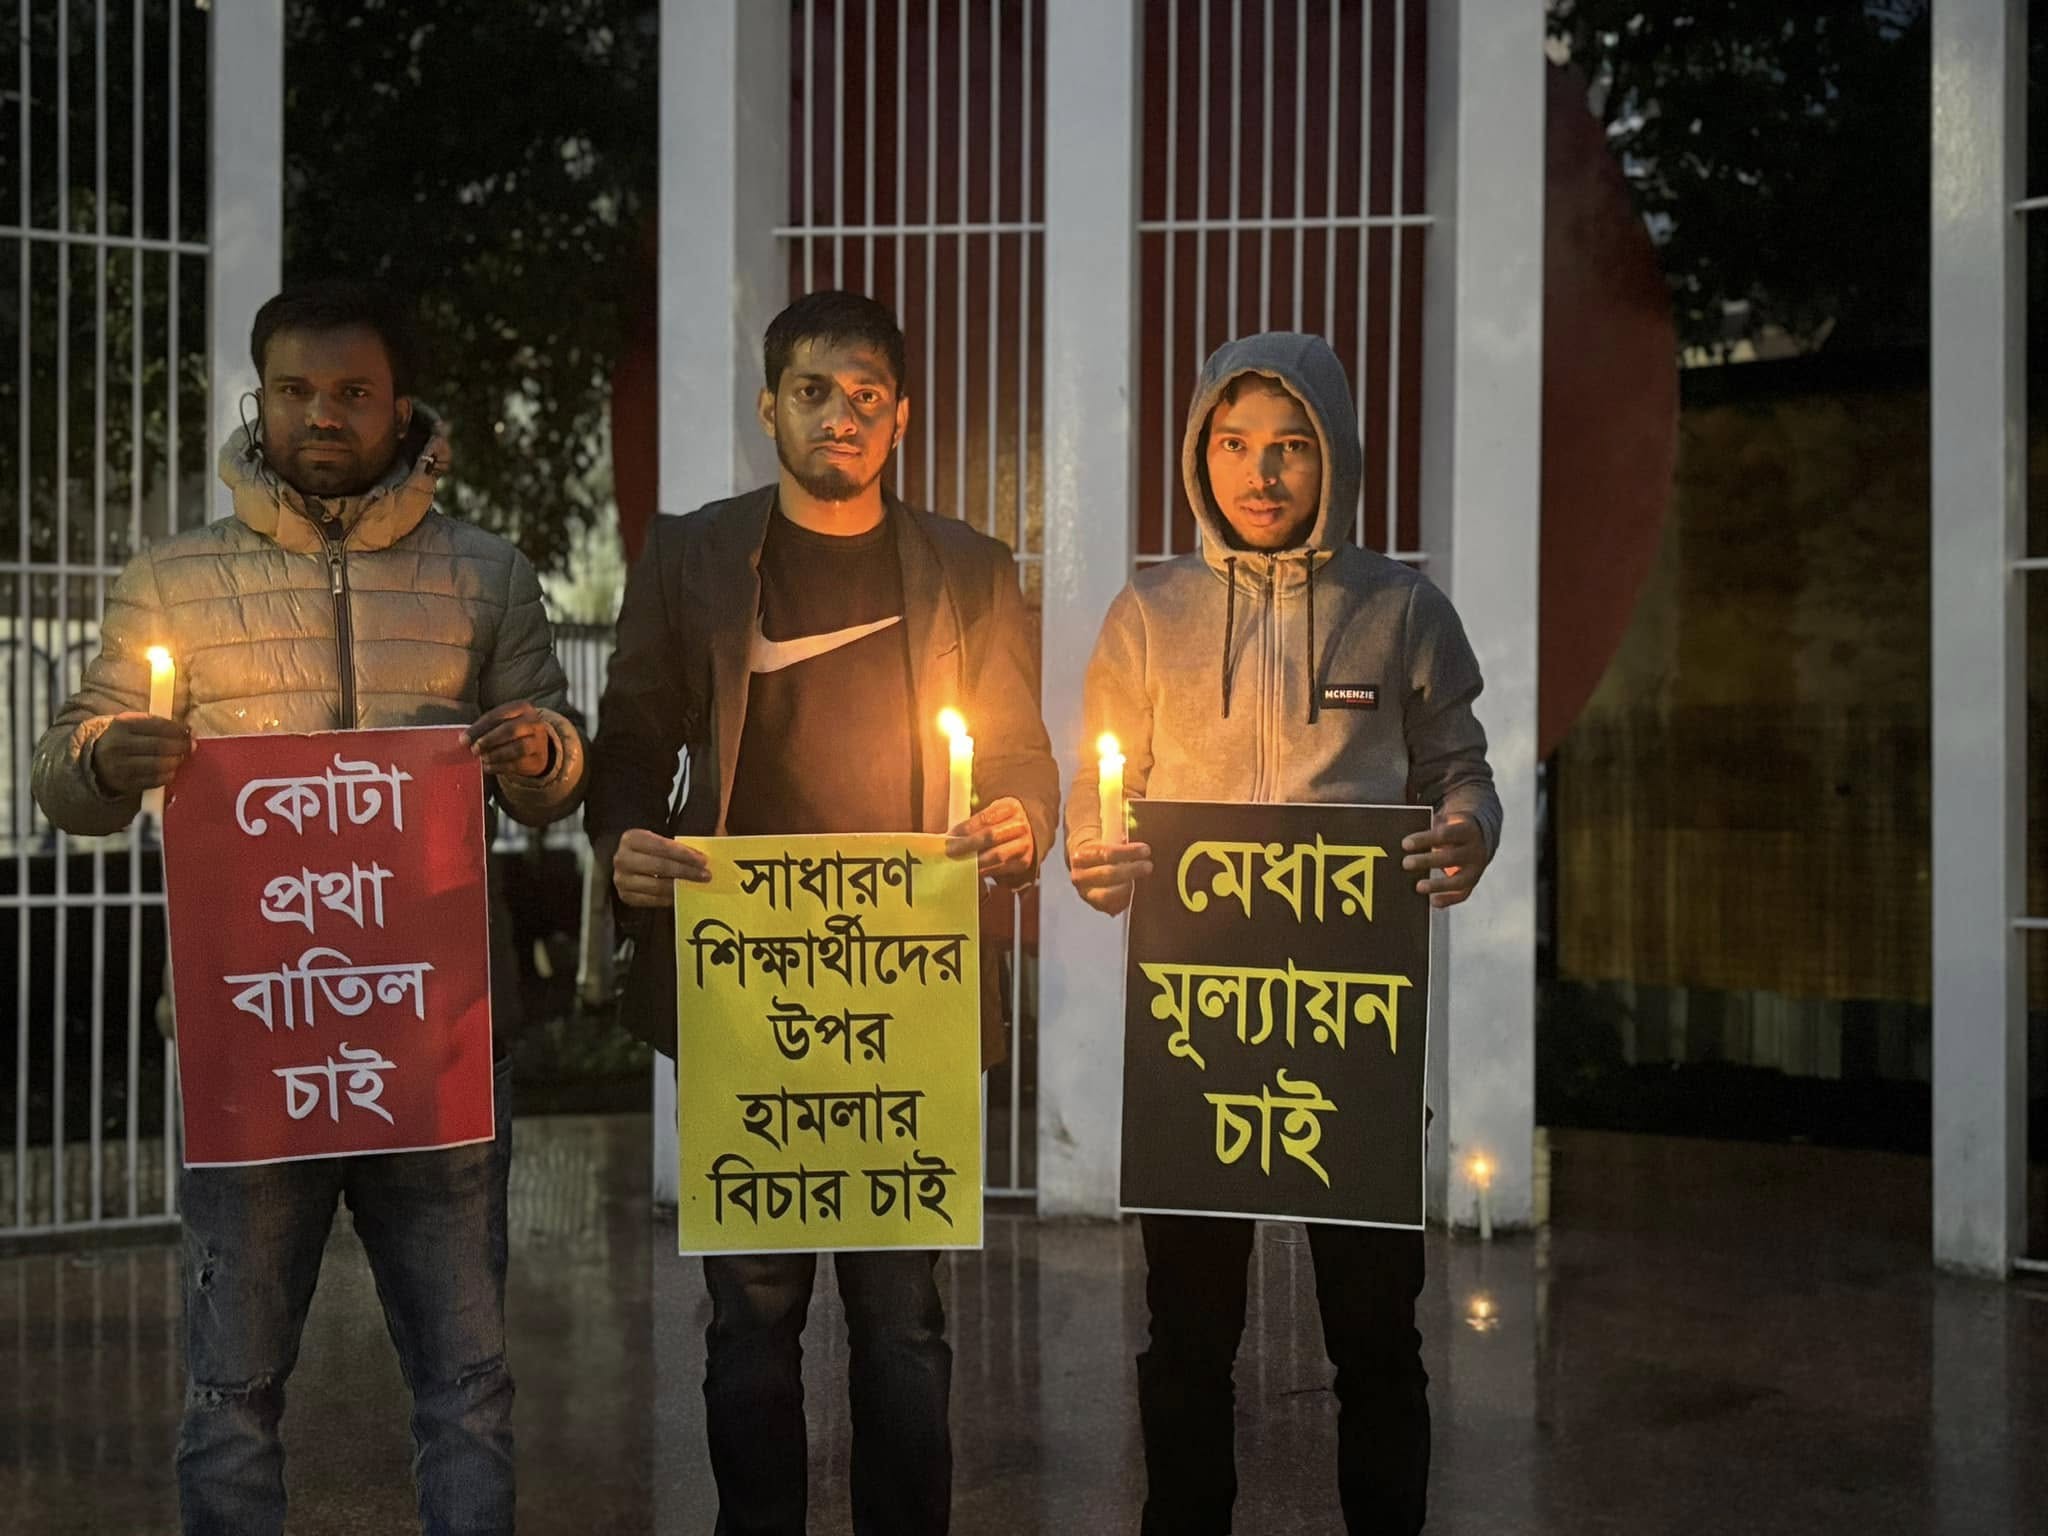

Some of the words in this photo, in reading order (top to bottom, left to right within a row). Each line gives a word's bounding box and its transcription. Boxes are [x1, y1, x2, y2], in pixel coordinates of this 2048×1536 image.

[1324, 689, 1375, 700] MCKENZIE
[235, 752, 413, 836] কোটা
[261, 861, 394, 934] প্রথা
[734, 850, 921, 911] সাধারণ
[1177, 832, 1388, 923] মেধার
[223, 947, 434, 1032] বাতিল
[687, 914, 969, 989] শিক্ষার্থীদের
[767, 996, 895, 1065] উপর
[1139, 957, 1413, 1070] মূল্যায়ন
[272, 1042, 397, 1125] চাই
[736, 1083, 926, 1150] হামলার
[1203, 1068, 1338, 1189] চাই
[705, 1153, 849, 1225] বিচার
[862, 1149, 957, 1228] চাই
